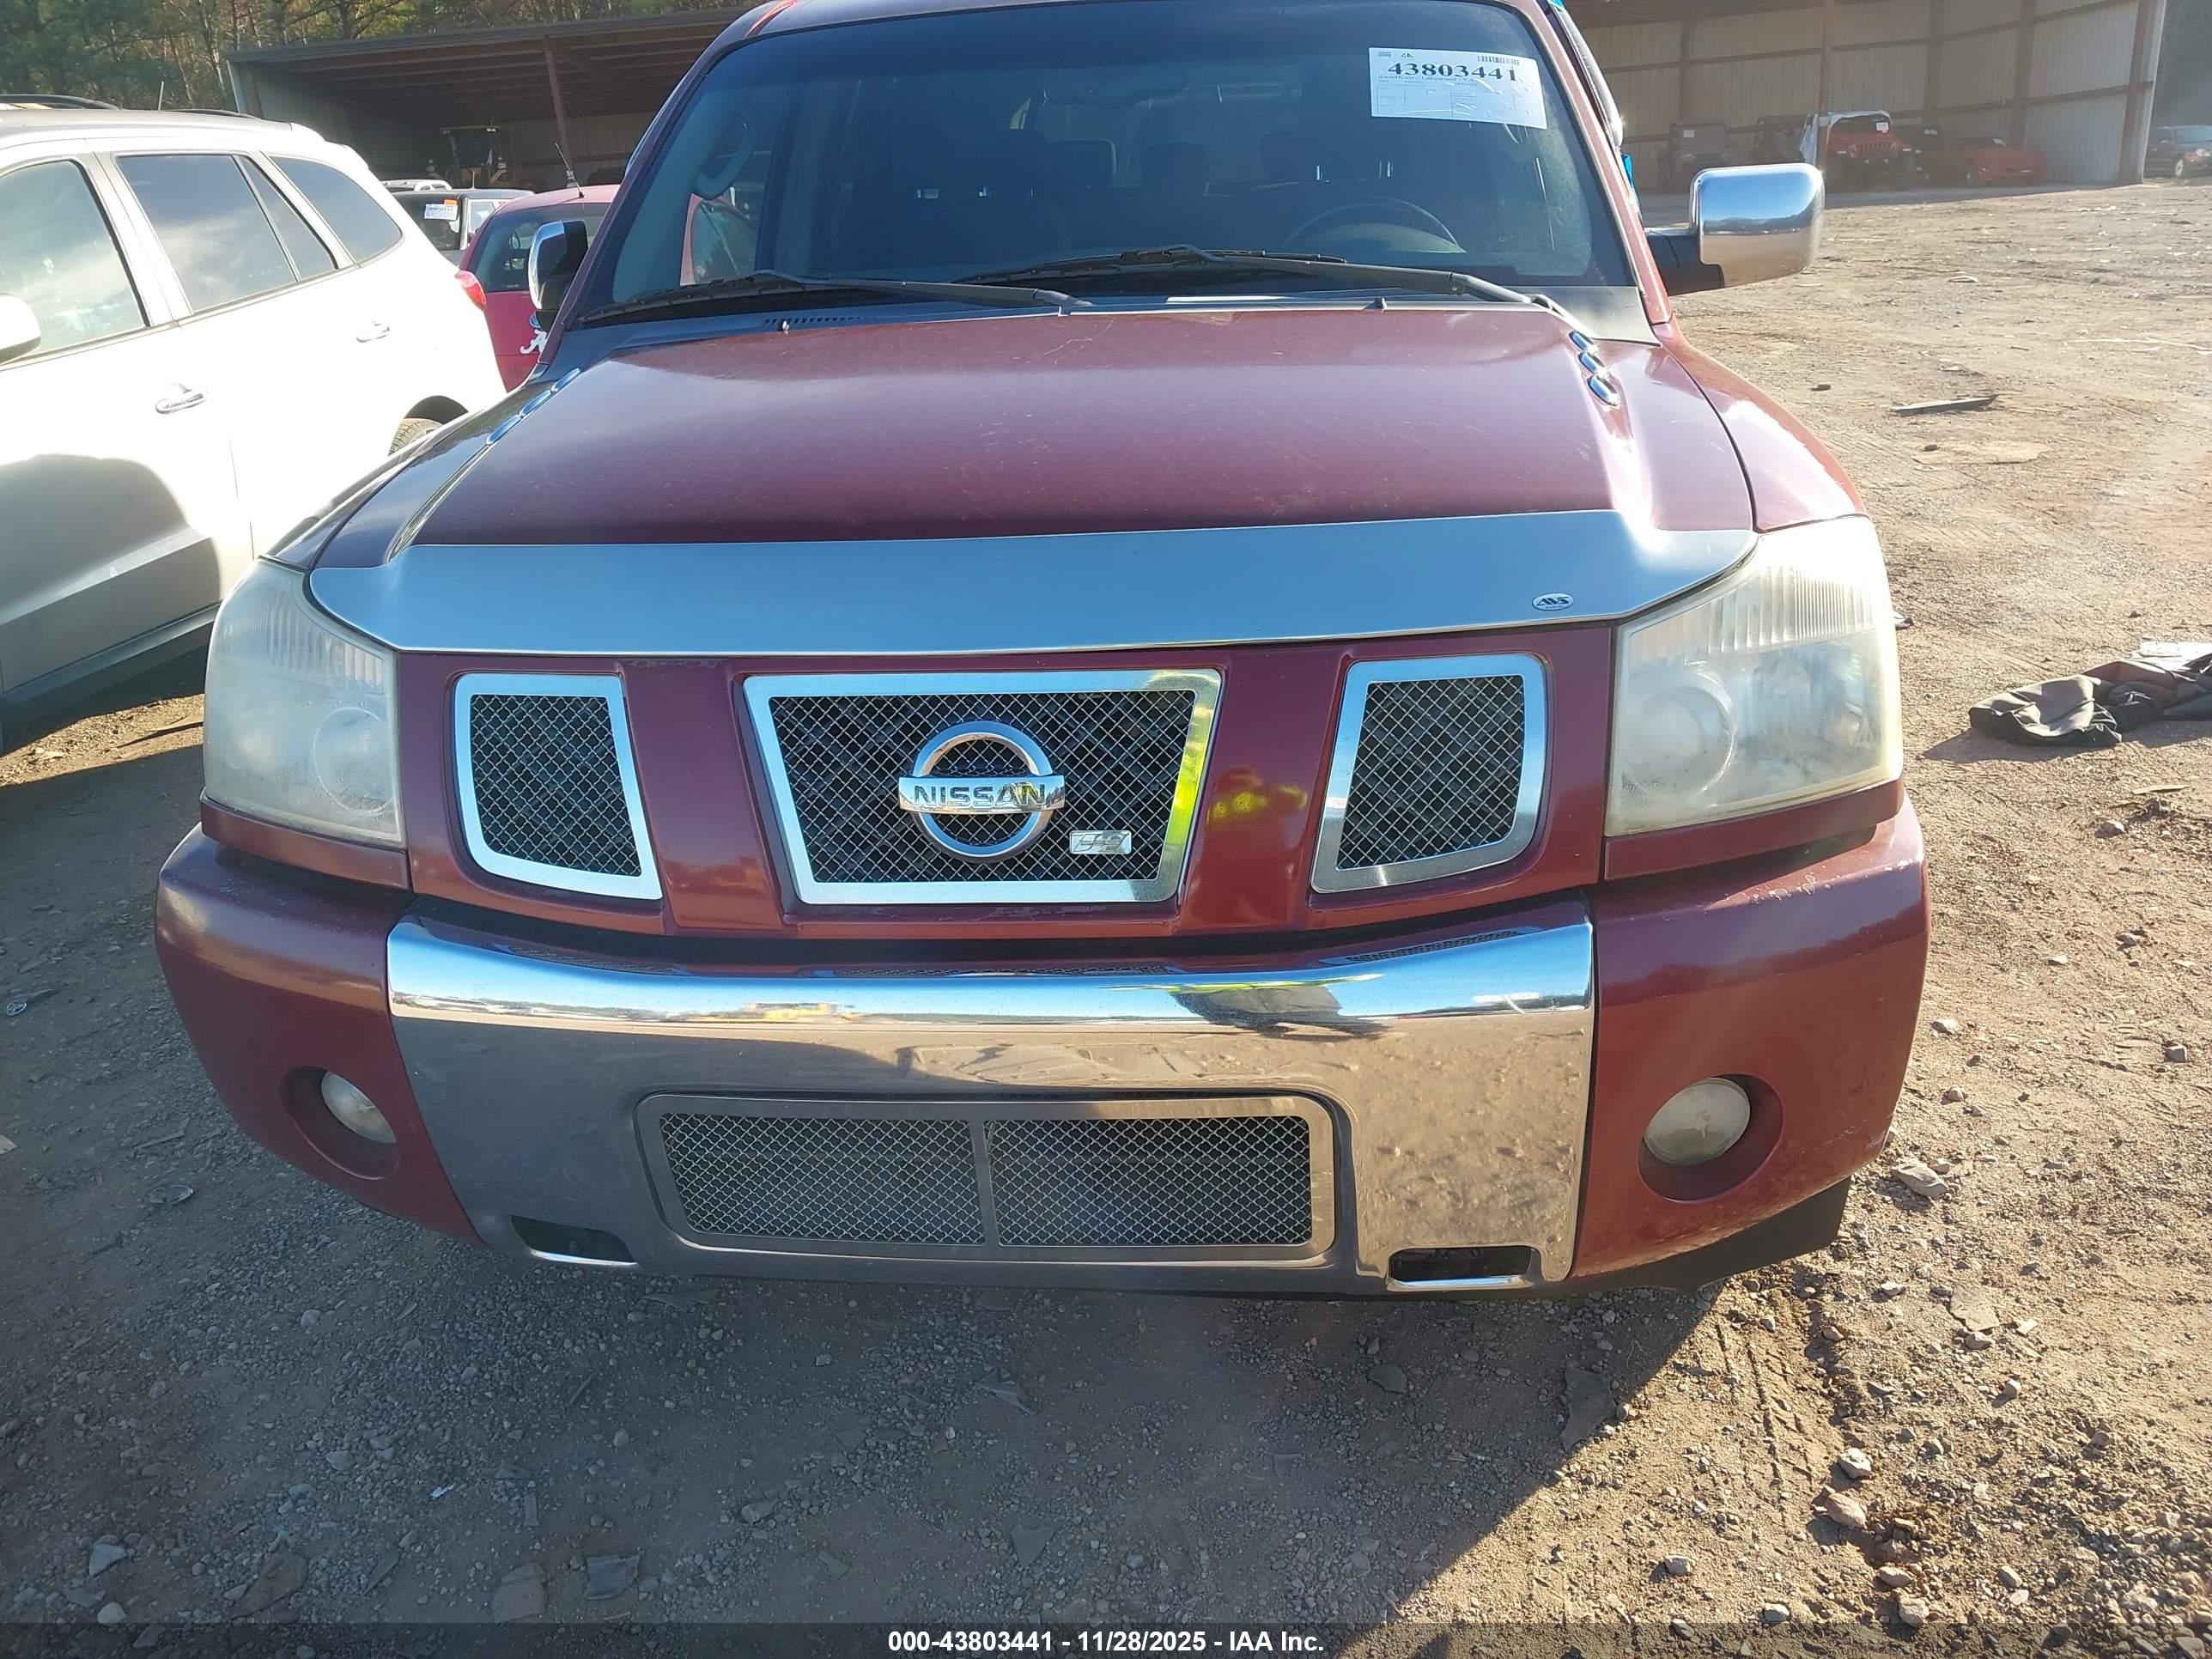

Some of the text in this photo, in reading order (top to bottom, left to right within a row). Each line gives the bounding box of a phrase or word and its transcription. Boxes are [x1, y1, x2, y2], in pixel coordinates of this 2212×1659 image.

[1388, 62, 1517, 81] 43803441
[1536, 596, 1570, 606] AVS
[914, 783, 1046, 808] NISSAN
